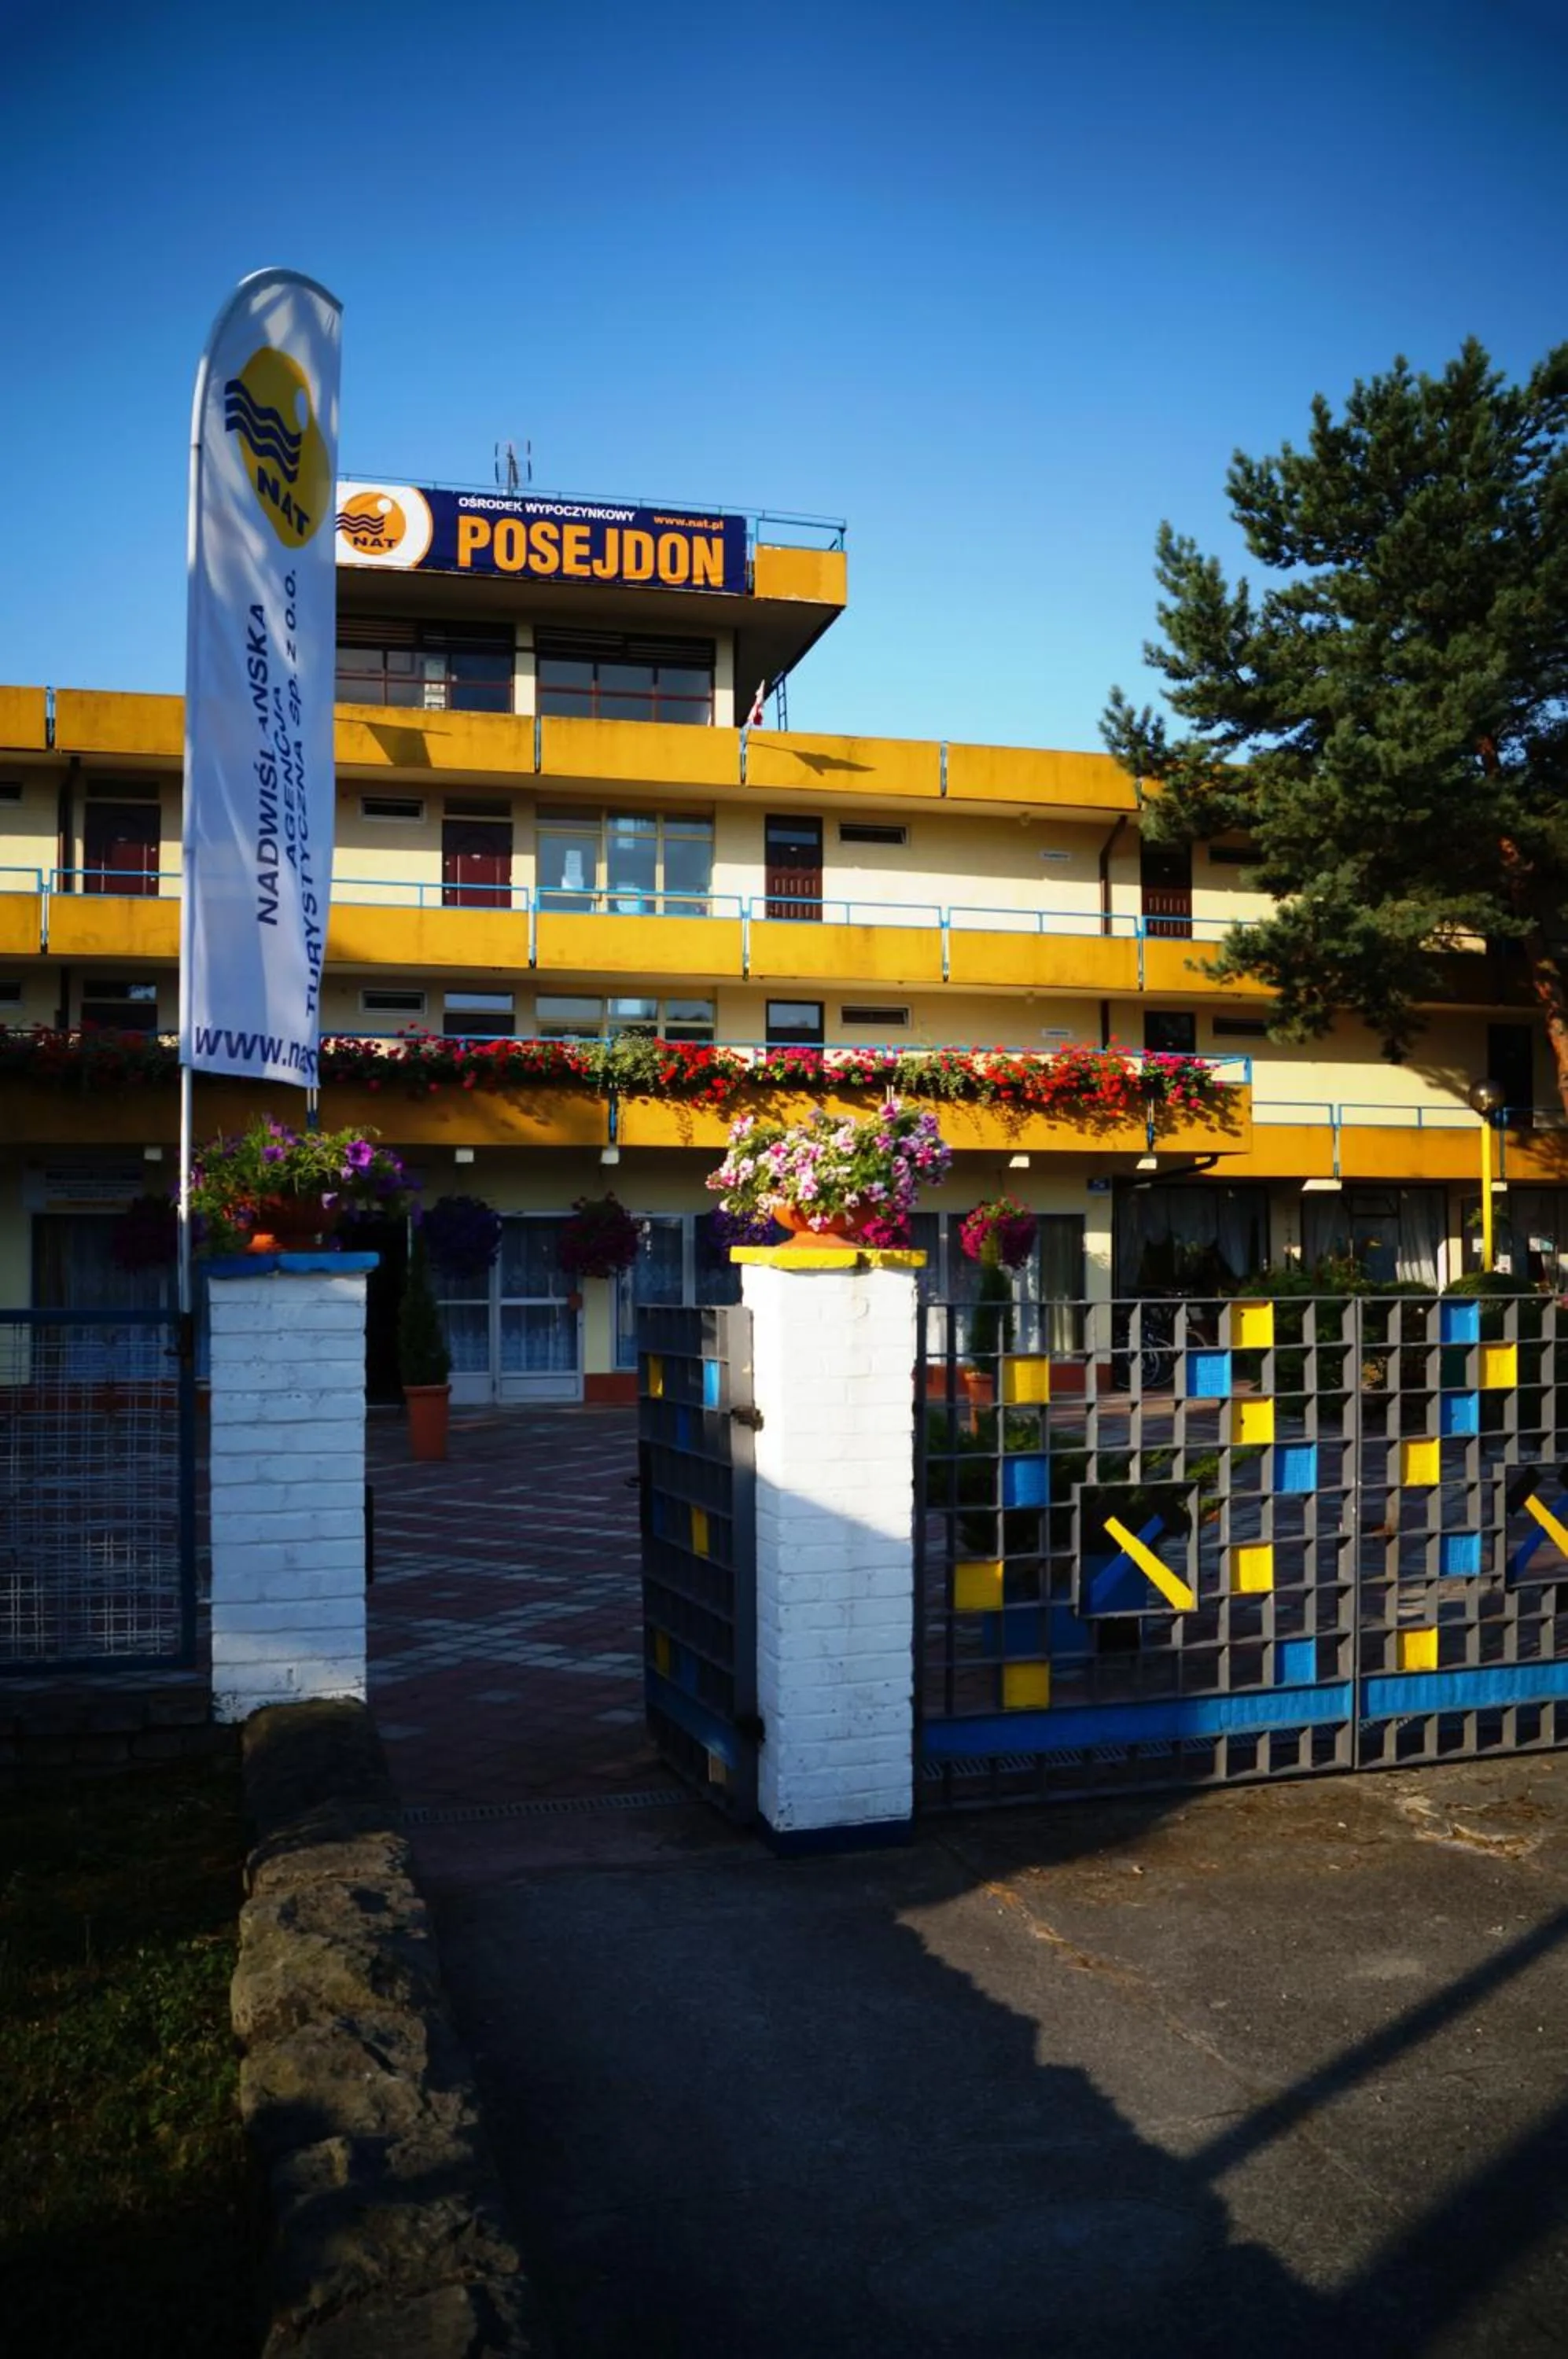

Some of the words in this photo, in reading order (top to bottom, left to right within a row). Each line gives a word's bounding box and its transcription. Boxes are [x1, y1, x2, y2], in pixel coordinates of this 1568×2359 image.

[256, 465, 311, 536] NAT
[458, 495, 522, 512] OŚRODEK
[525, 502, 635, 522] WYPOCZYNKOWY
[653, 514, 724, 531] www.nat.pl
[353, 536, 397, 548] NAT
[458, 514, 725, 587] POSEJDON
[285, 639, 296, 662] z
[273, 686, 297, 868] AGENCJA
